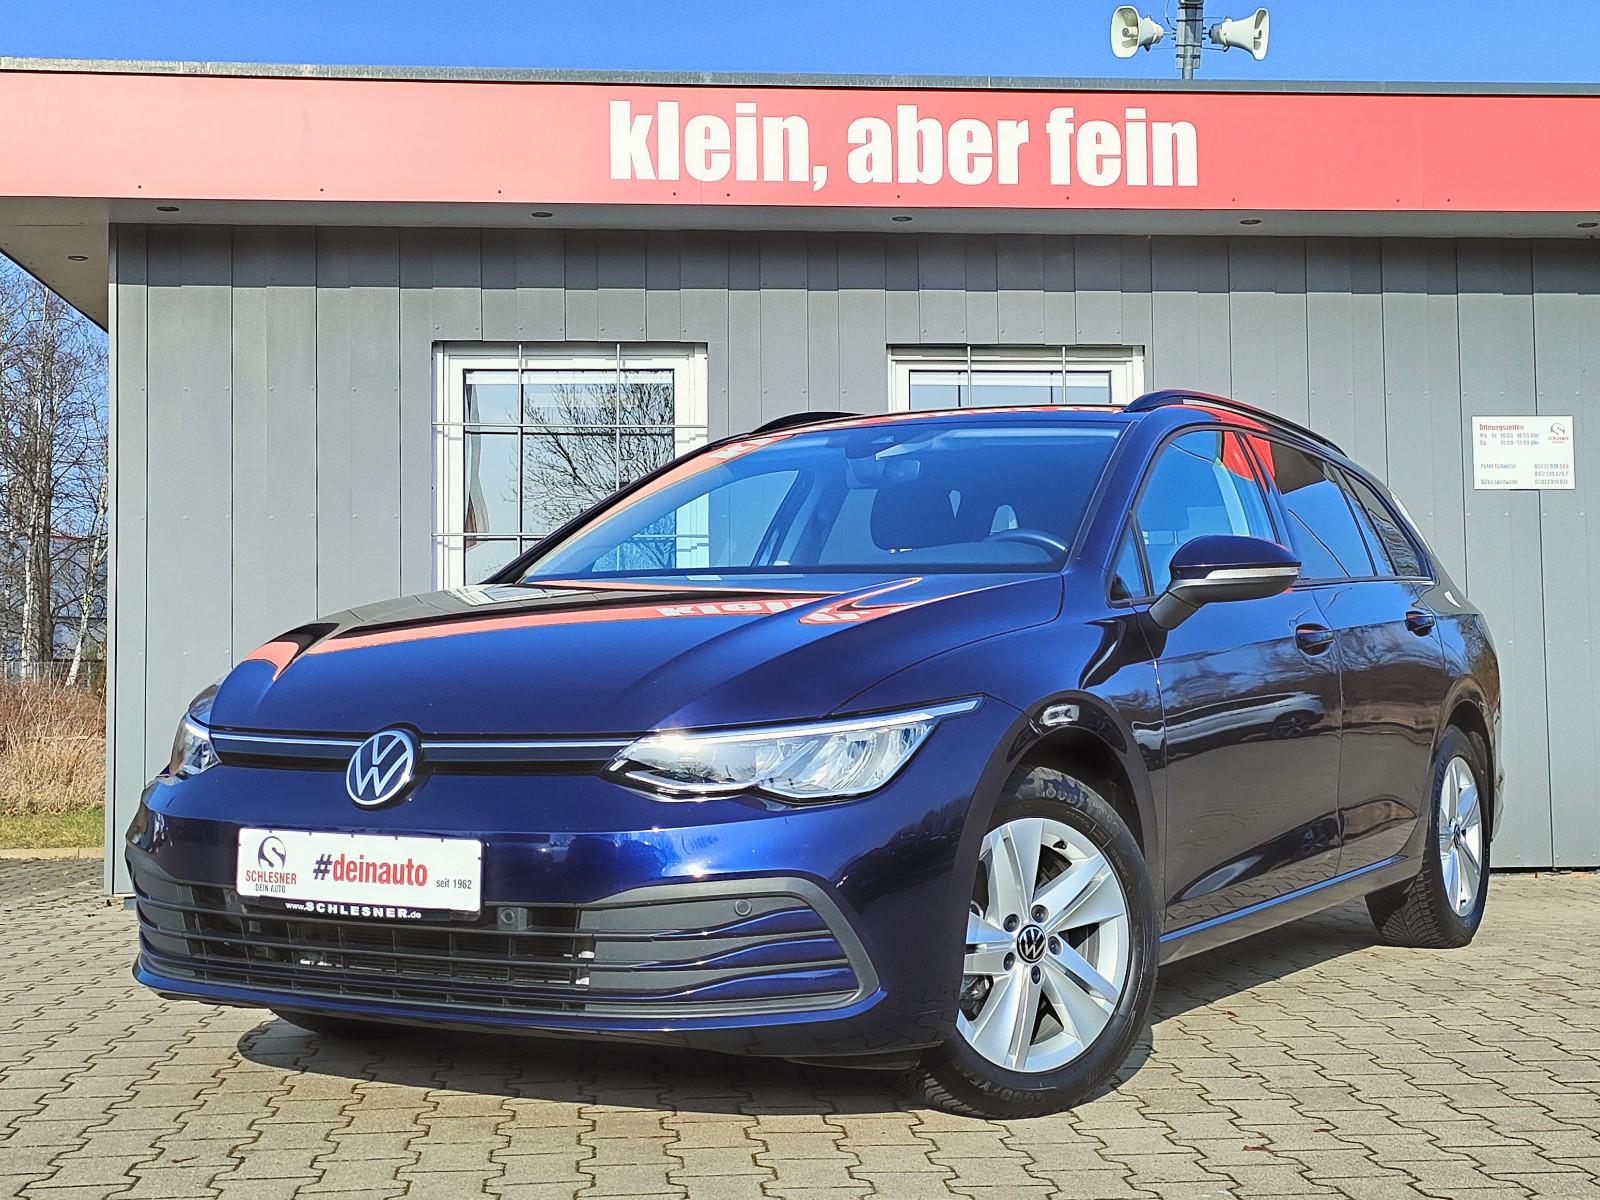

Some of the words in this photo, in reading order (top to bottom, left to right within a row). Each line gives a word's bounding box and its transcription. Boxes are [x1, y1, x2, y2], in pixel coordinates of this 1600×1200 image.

[609, 99, 828, 192] klein,
[847, 104, 1029, 185] aber
[1045, 105, 1198, 188] fein
[245, 869, 297, 886] SCHLESNER
[312, 853, 428, 887] #deinauto
[255, 883, 269, 892] DEIN
[270, 884, 286, 893] AUTO
[436, 878, 450, 889] seit
[453, 878, 472, 890] 1962
[285, 900, 422, 919] www.SCHLESNER.de
